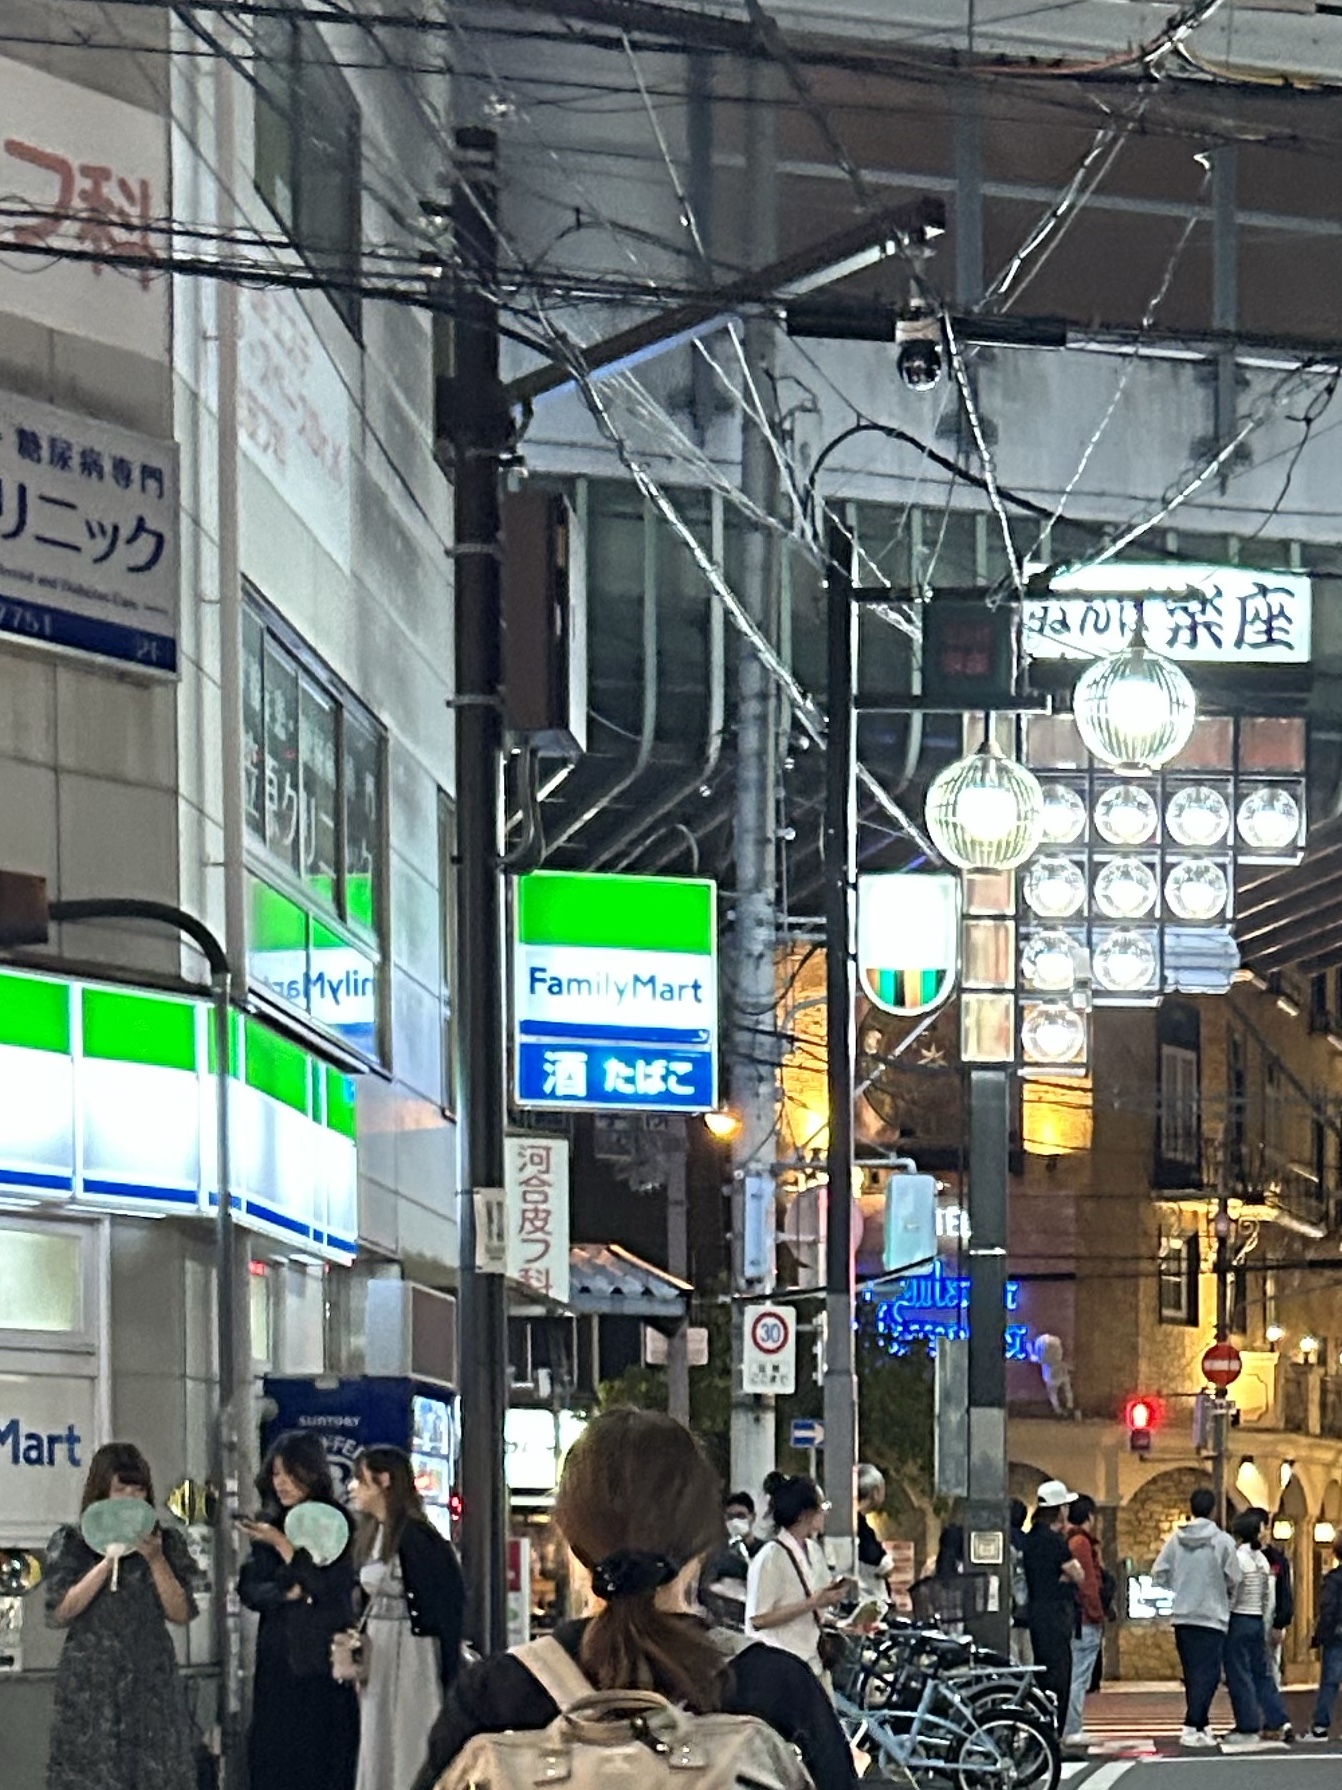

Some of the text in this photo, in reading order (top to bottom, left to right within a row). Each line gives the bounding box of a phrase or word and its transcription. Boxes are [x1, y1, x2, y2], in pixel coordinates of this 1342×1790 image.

[17, 427, 165, 500] 糖尿病専門
[0, 476, 165, 573] リニック
[529, 966, 703, 1006] FamilyMart
[543, 1051, 696, 1097] 酒 たばこ
[518, 1144, 554, 1296] 河合皮フ科
[761, 1323, 781, 1343] 30
[0, 1418, 82, 1467] Mart
